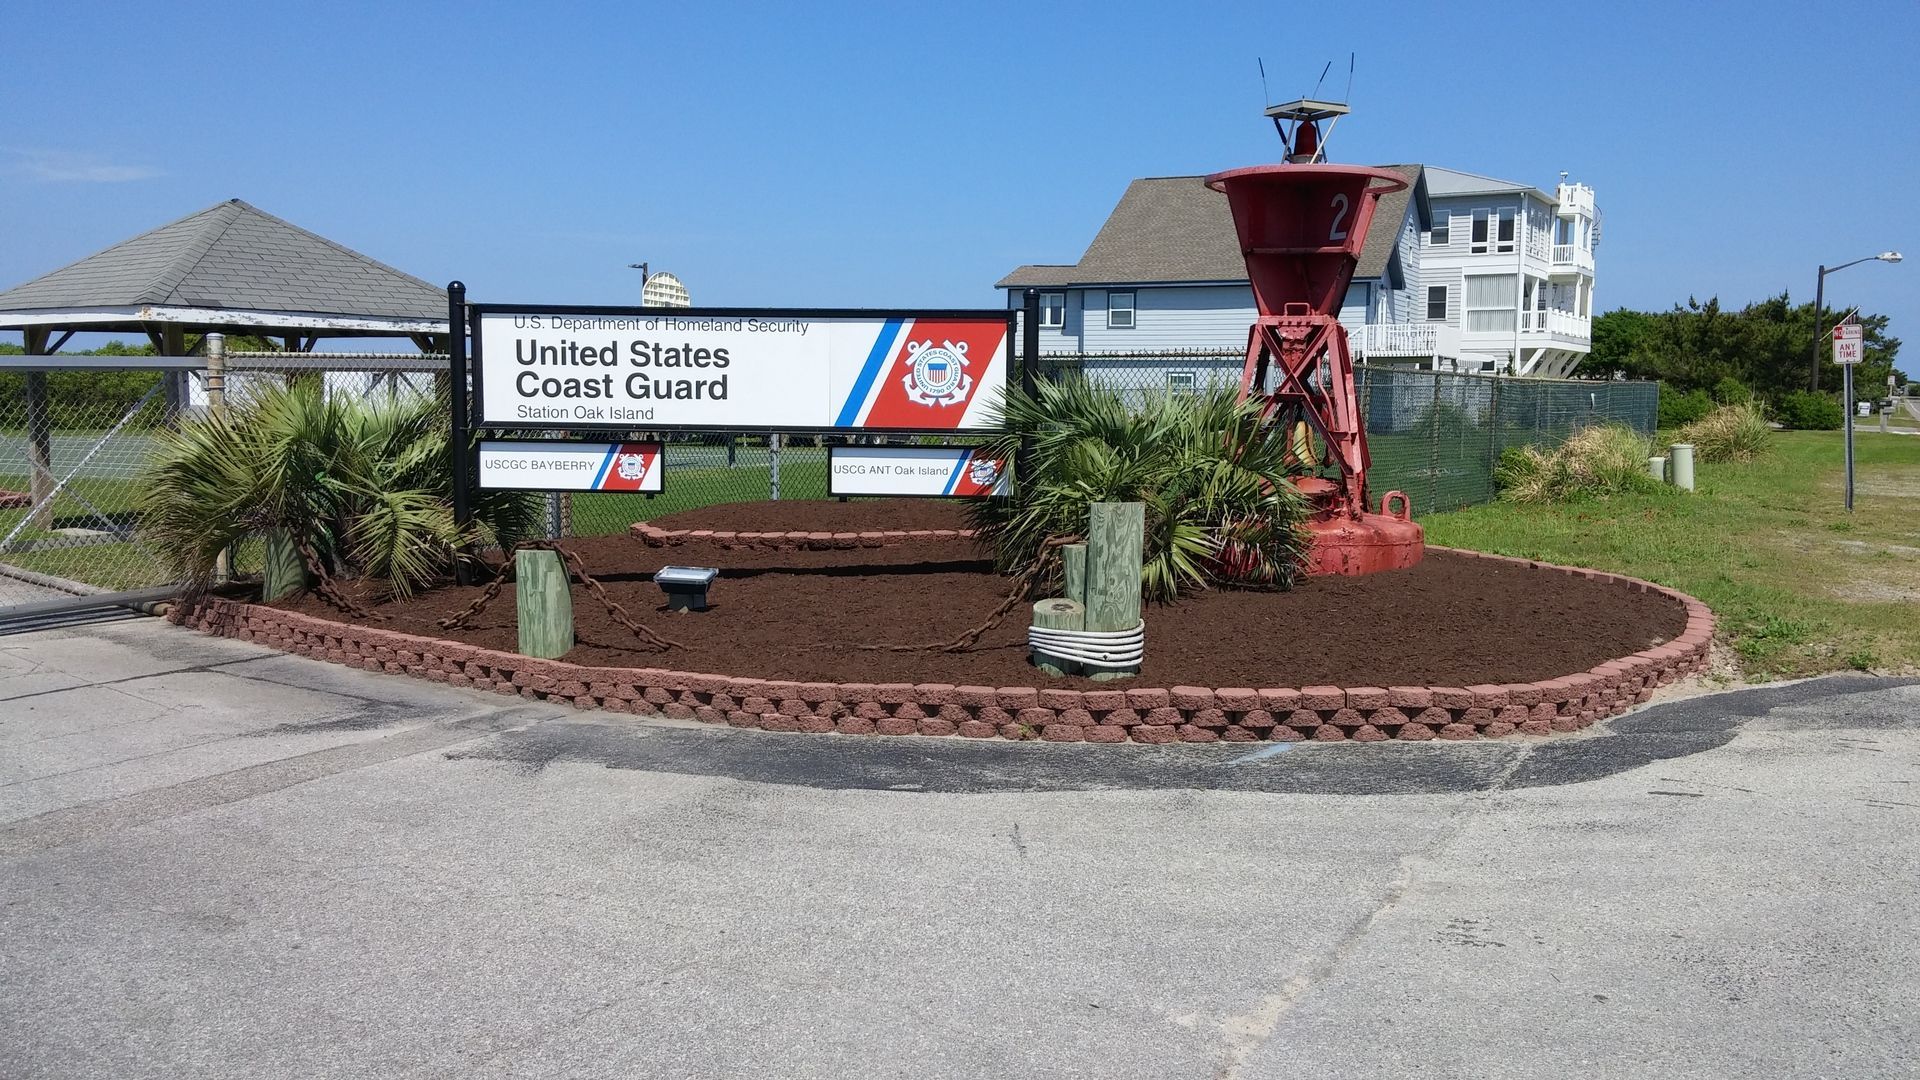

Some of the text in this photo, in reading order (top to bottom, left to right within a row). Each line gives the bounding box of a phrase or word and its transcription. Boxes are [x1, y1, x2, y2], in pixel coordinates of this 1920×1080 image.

[1329, 193, 1349, 240] 2
[514, 315, 809, 335] U.S. Department of Homeland Security
[515, 338, 730, 368] United States
[1839, 343, 1856, 351] ANY
[1839, 350, 1857, 358] TIME
[917, 350, 937, 367] STATES
[938, 350, 957, 366] COAST
[515, 371, 728, 400] Coast Guard
[946, 367, 959, 390] GUARD
[517, 404, 654, 420] Station Oak Island
[485, 459, 595, 471] USCGC BAYBERRY
[834, 464, 949, 476] USCG ANT Oak Island
